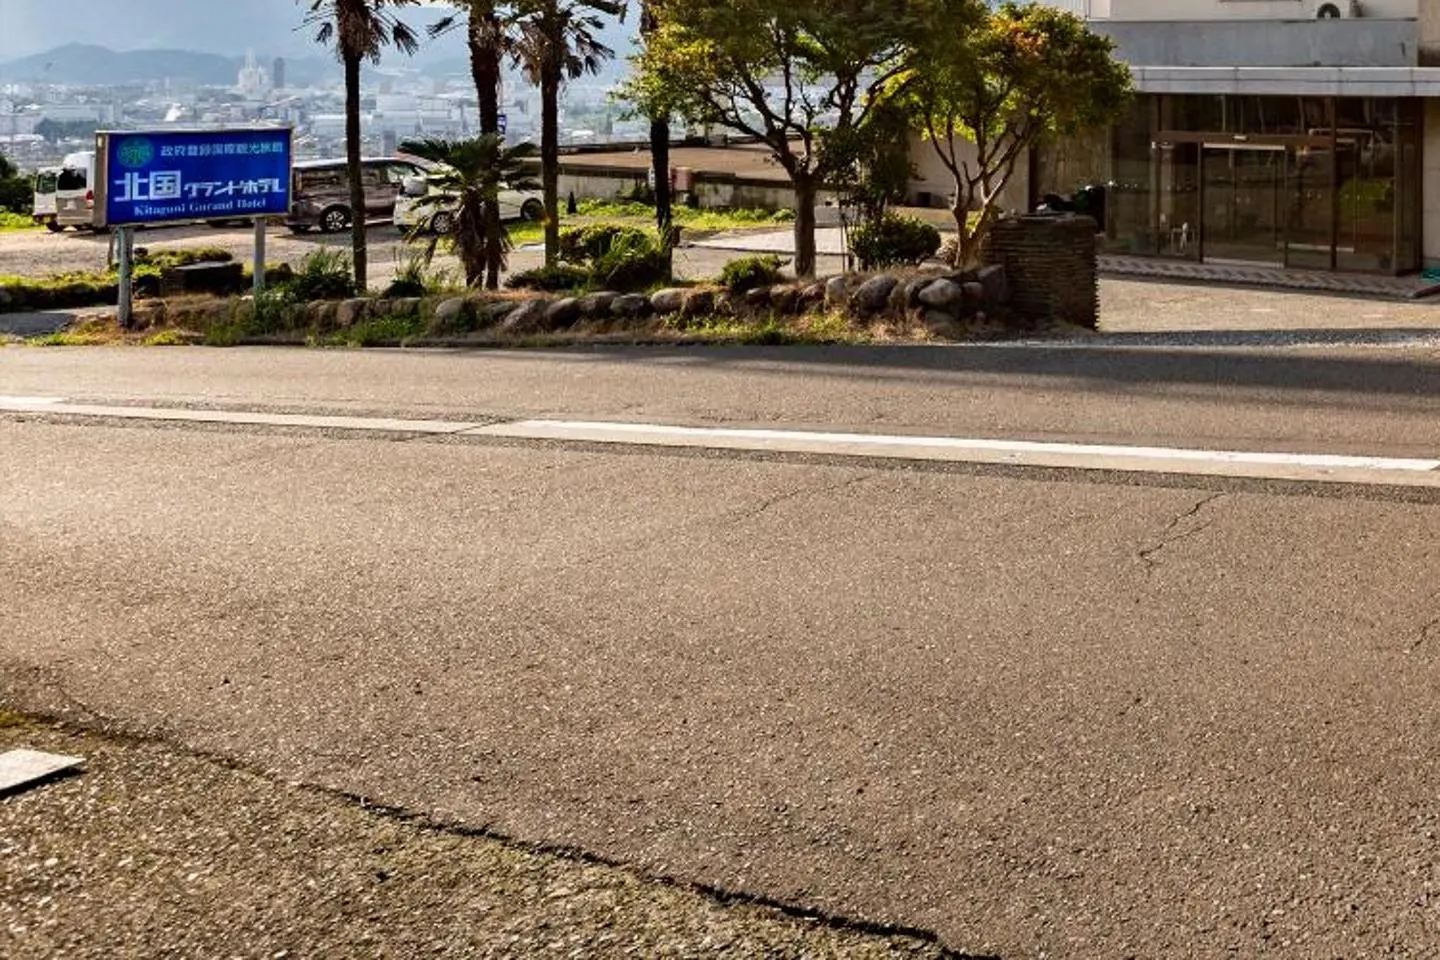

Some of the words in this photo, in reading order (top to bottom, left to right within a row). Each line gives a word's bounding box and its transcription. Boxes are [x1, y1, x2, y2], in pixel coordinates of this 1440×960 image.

[114, 170, 286, 202] 北国グランドホテル
[237, 198, 266, 208] Hotel
